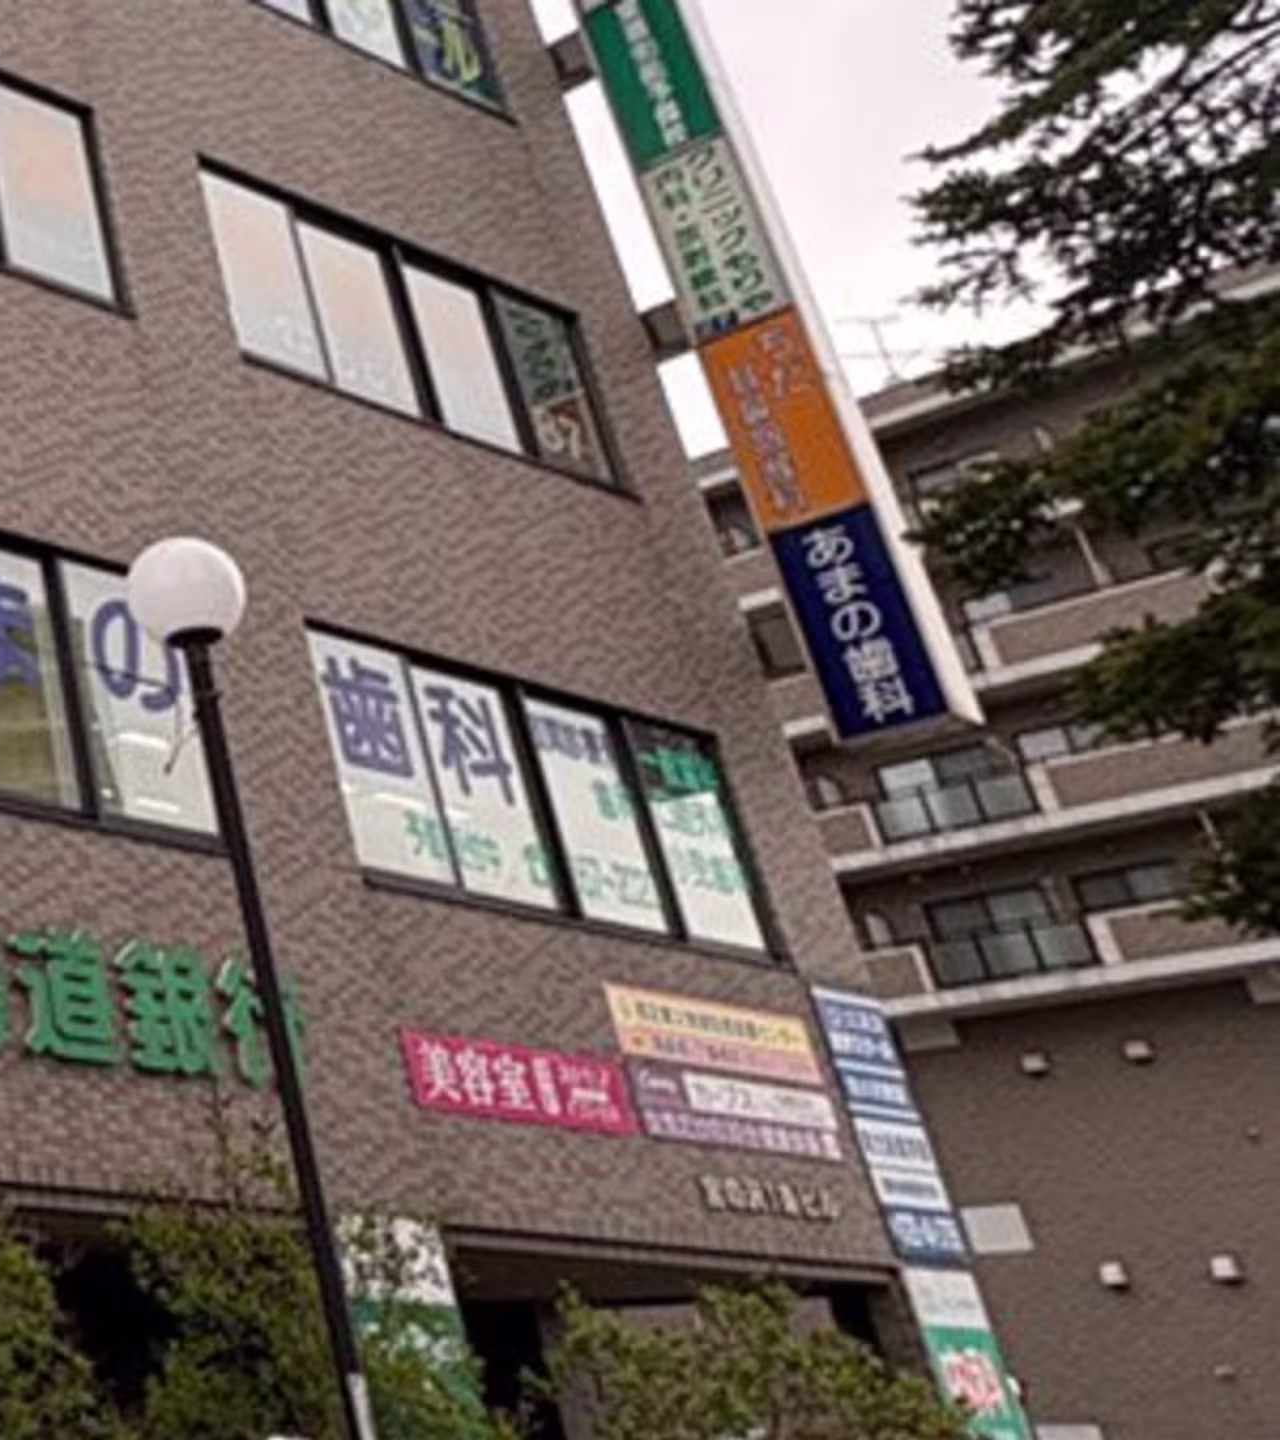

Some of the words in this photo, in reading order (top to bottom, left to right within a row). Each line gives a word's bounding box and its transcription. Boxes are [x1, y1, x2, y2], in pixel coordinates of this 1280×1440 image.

[801, 524, 915, 722] あまの歯科
[320, 653, 517, 807] 歯科
[417, 1039, 537, 1111] 美容室
